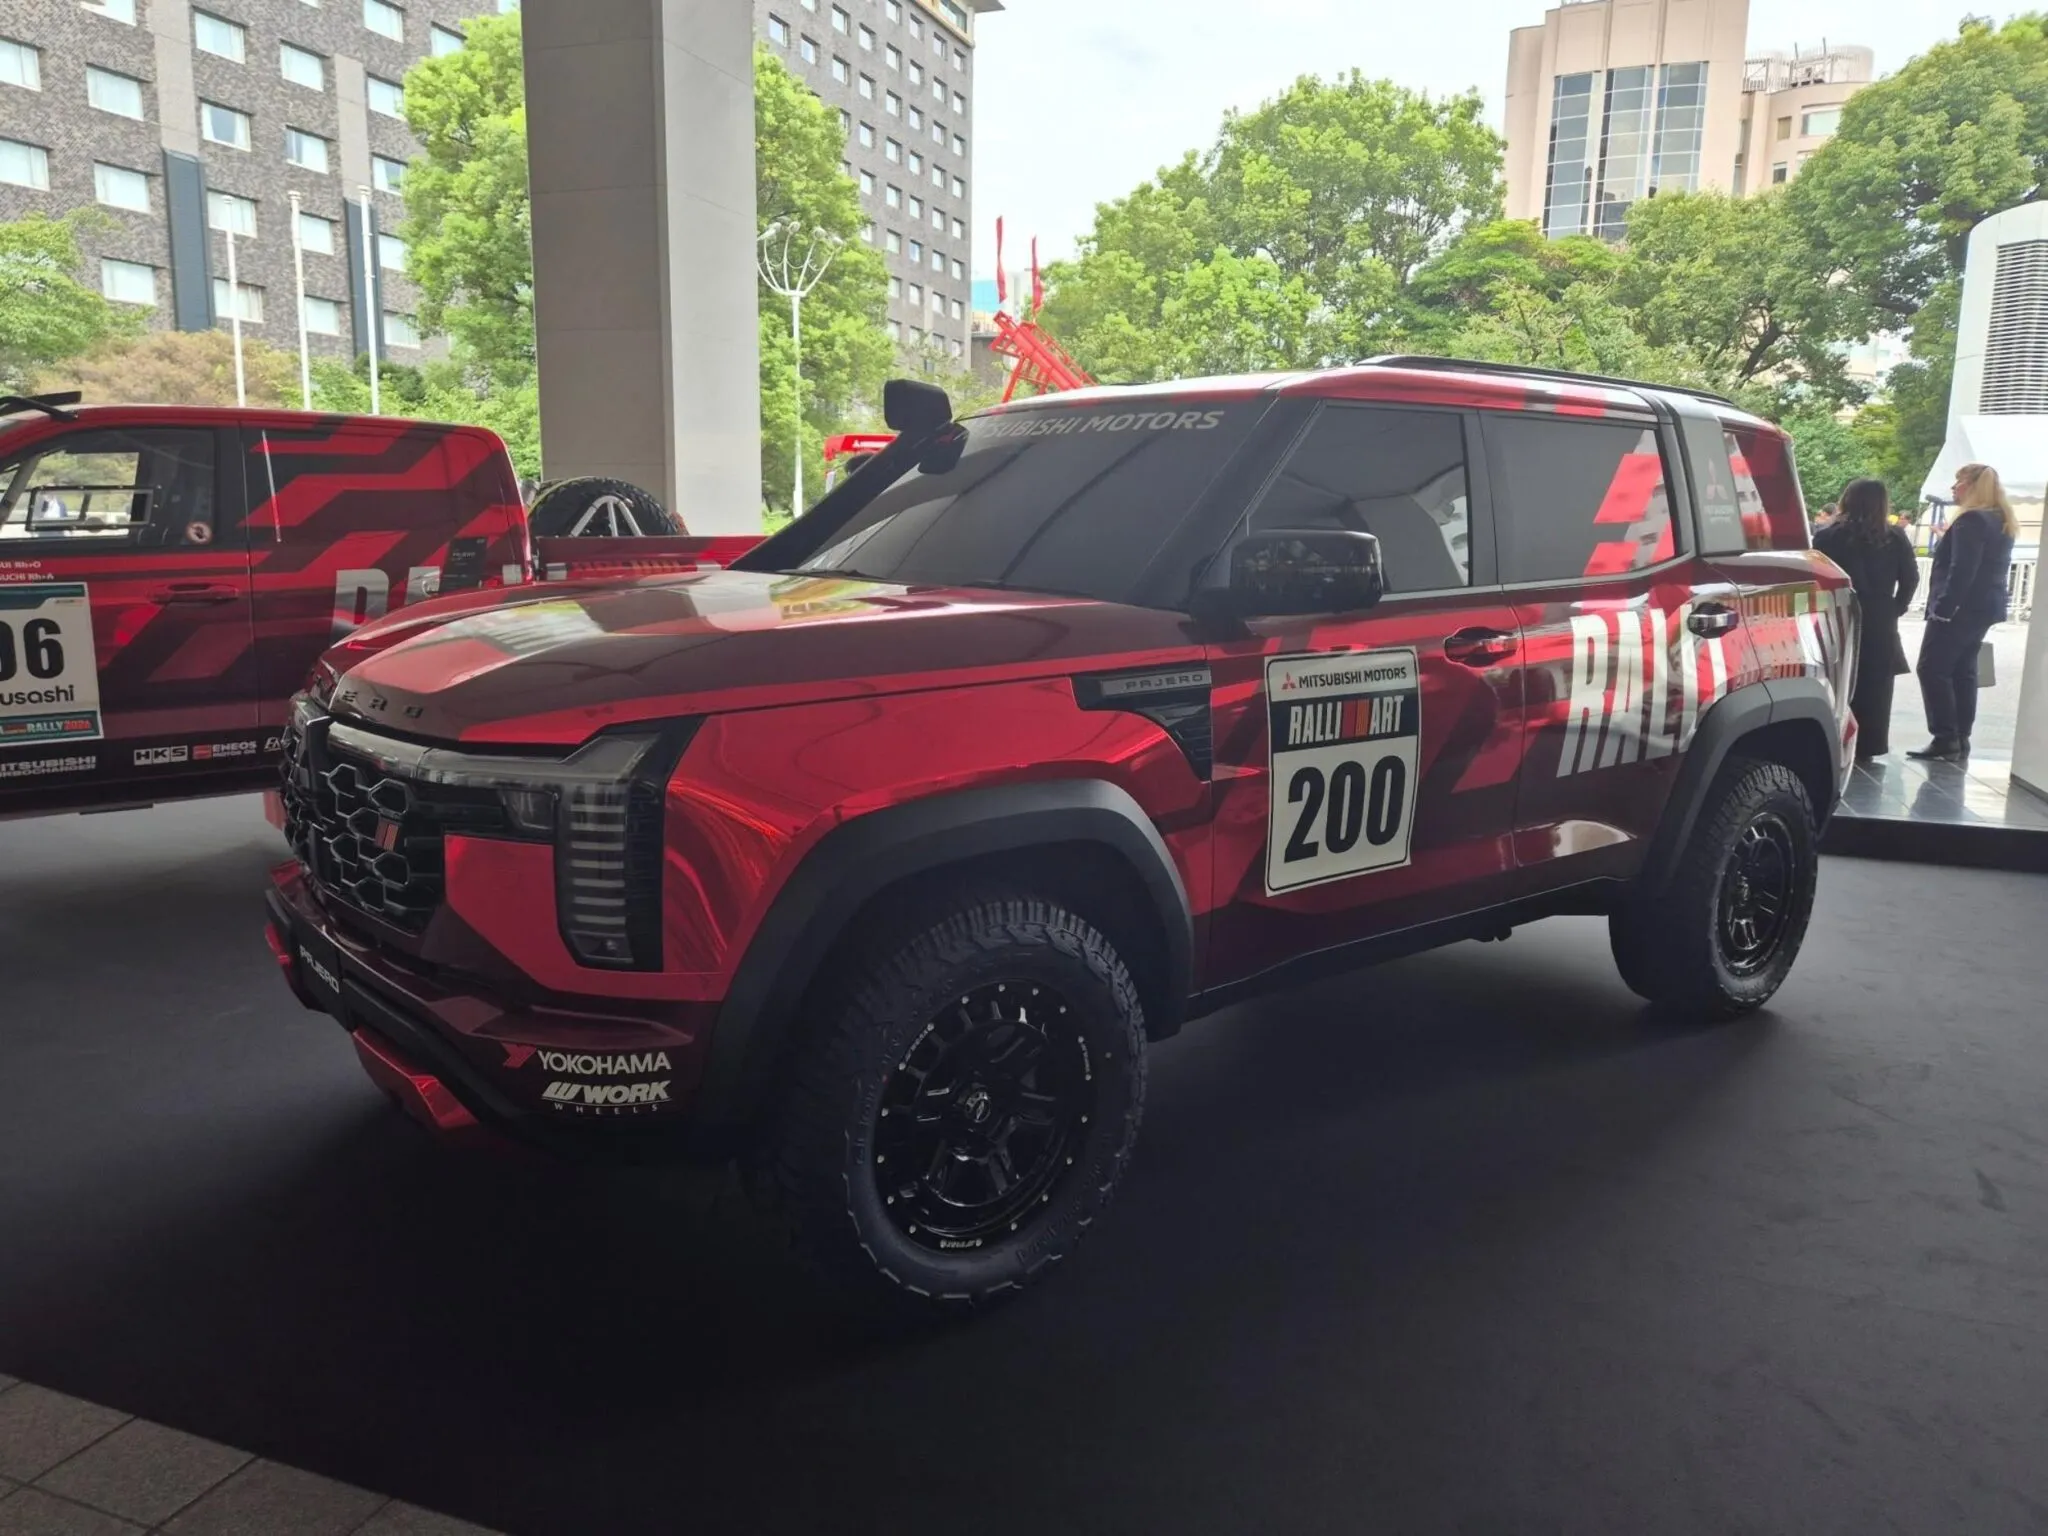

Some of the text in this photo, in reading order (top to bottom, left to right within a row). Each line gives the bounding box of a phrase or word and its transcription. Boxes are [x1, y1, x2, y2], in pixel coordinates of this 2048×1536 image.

[1079, 411, 1225, 433] MOTORS
[1124, 674, 1203, 690] PAJERO
[1299, 667, 1407, 688] MITSUBISHI MOTORS
[135, 746, 188, 763] HKS
[213, 741, 257, 752] ENEOS
[1284, 755, 1406, 863] 200
[537, 1050, 672, 1075] YOKOHAMA
[582, 1080, 671, 1104] WORK
[554, 1102, 658, 1115] WHEELS
